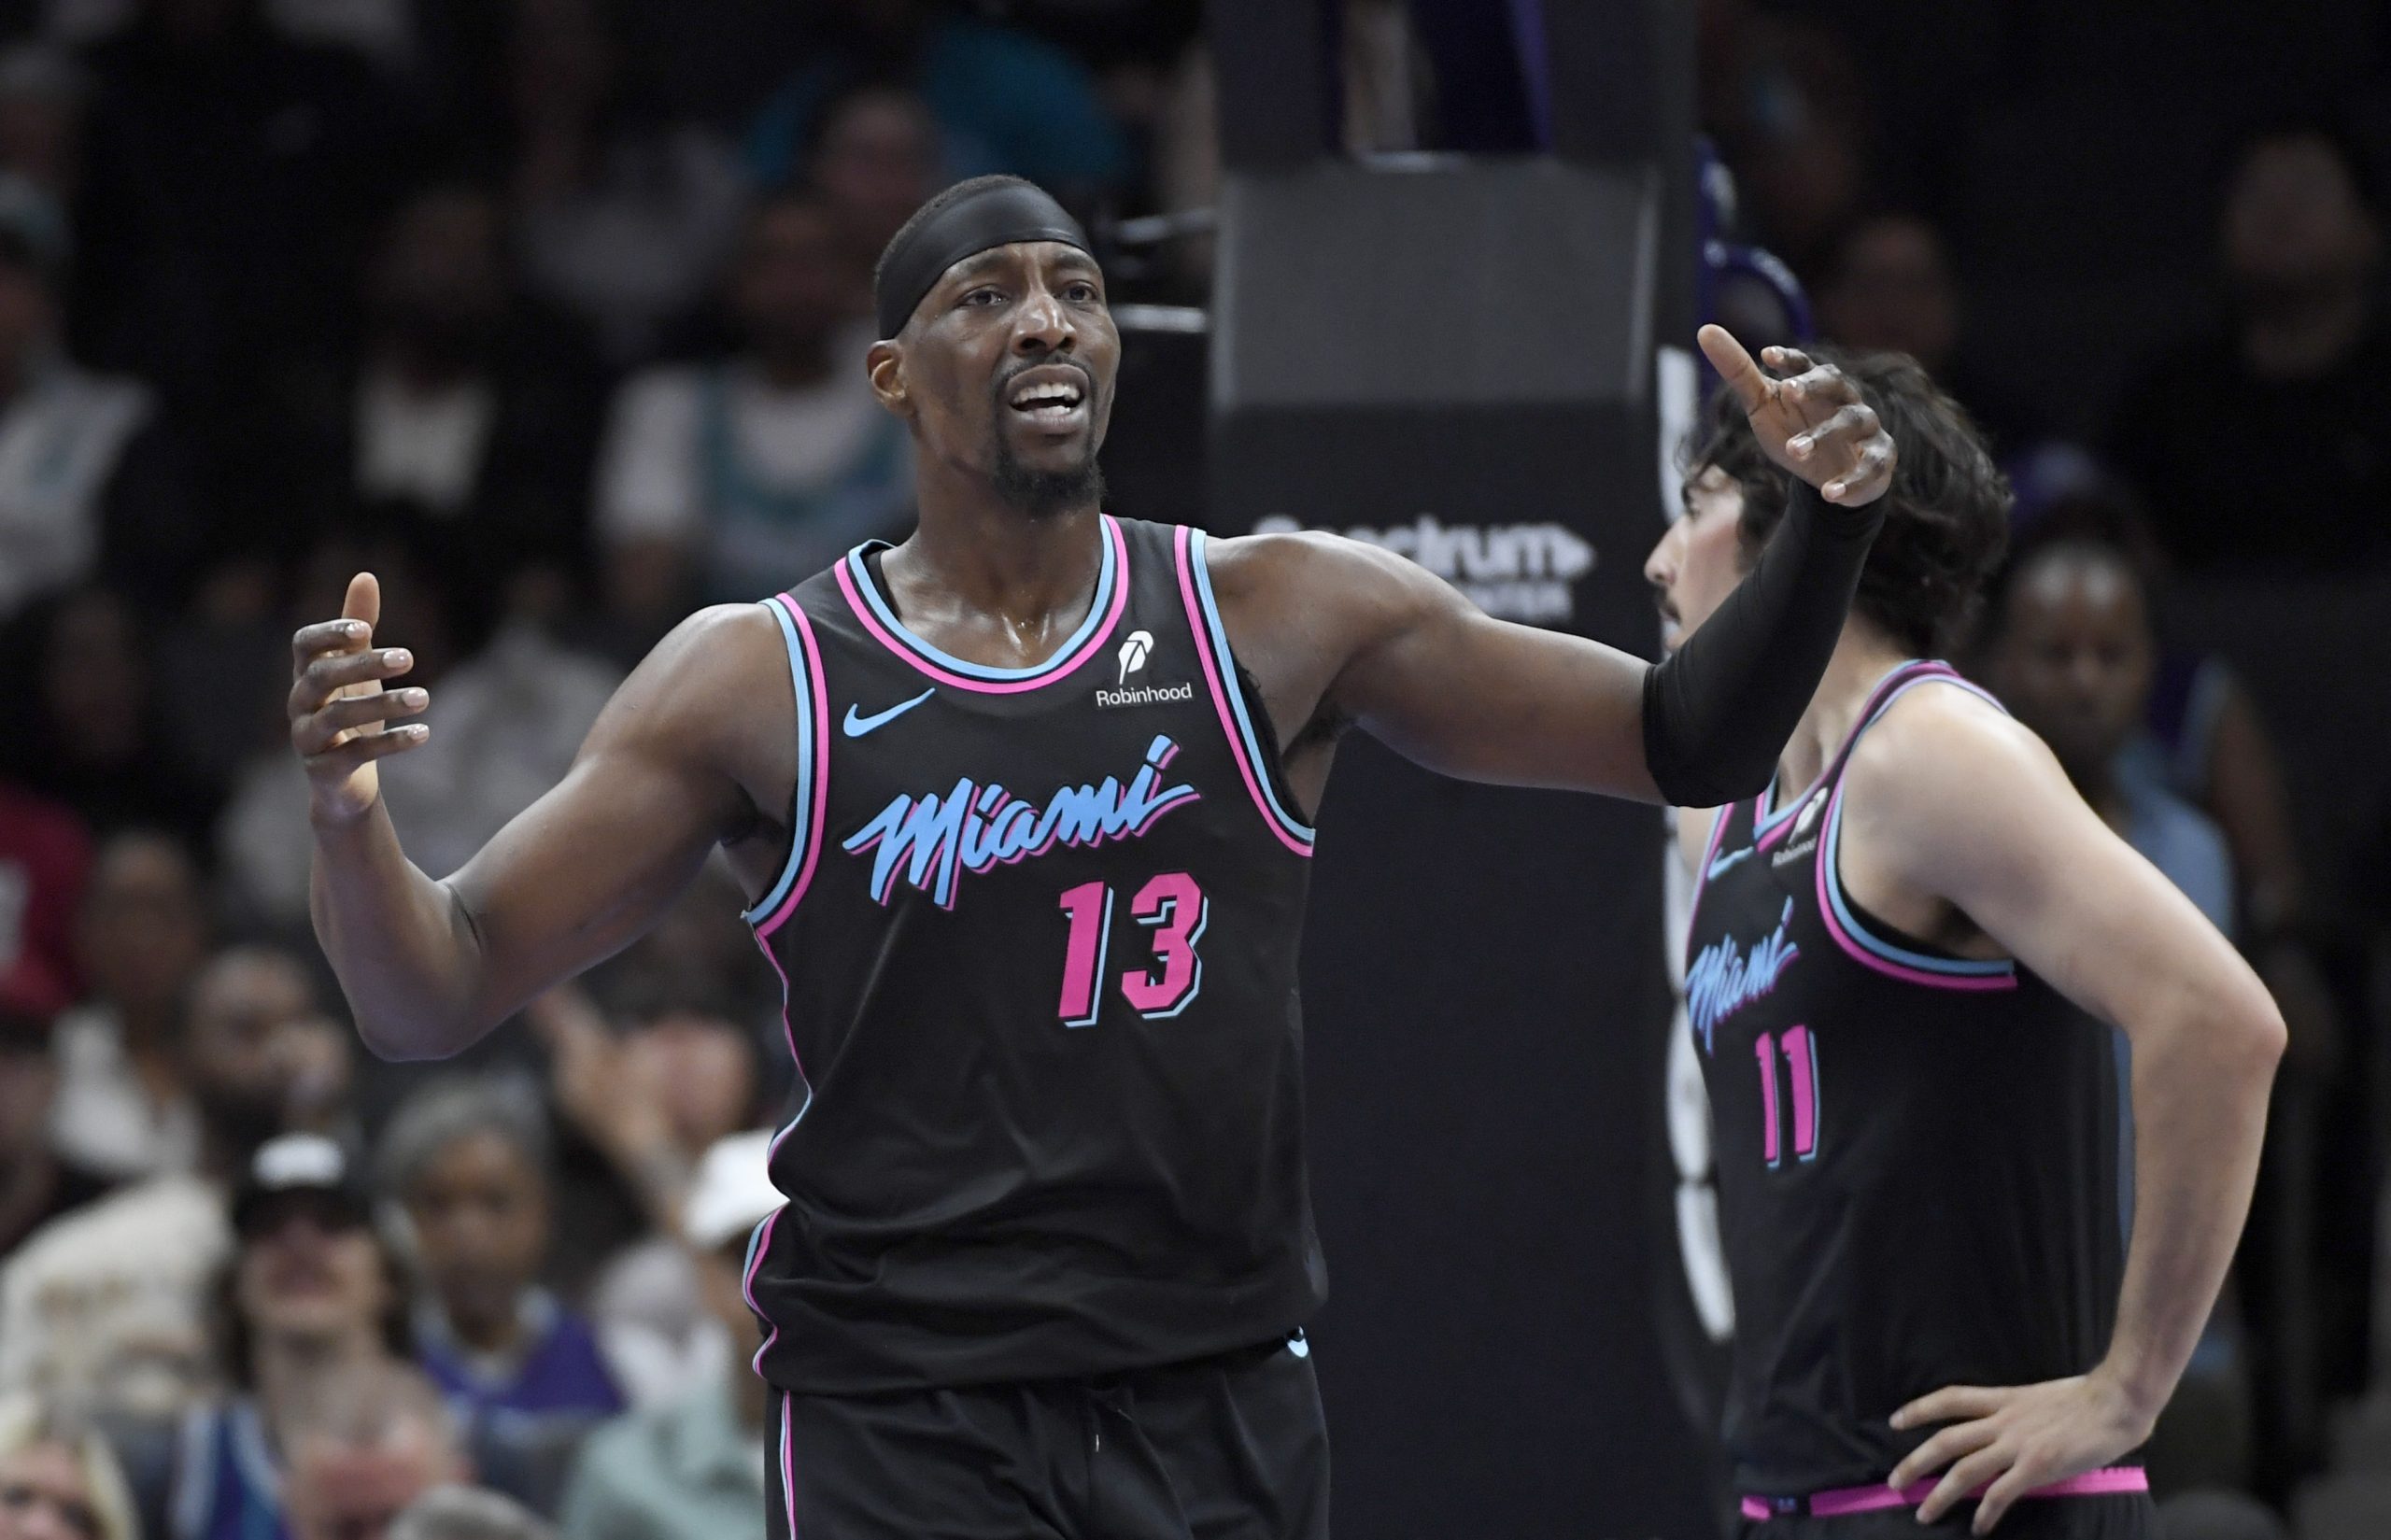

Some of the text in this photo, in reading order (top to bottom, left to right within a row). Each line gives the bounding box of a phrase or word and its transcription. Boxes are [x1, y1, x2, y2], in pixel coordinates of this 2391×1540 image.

[1096, 682, 1193, 707] Robinhood
[842, 734, 1201, 911] Miami
[1057, 871, 1209, 1027] 13
[1684, 894, 1800, 1057] Miami
[1754, 1024, 1820, 1168] 11
